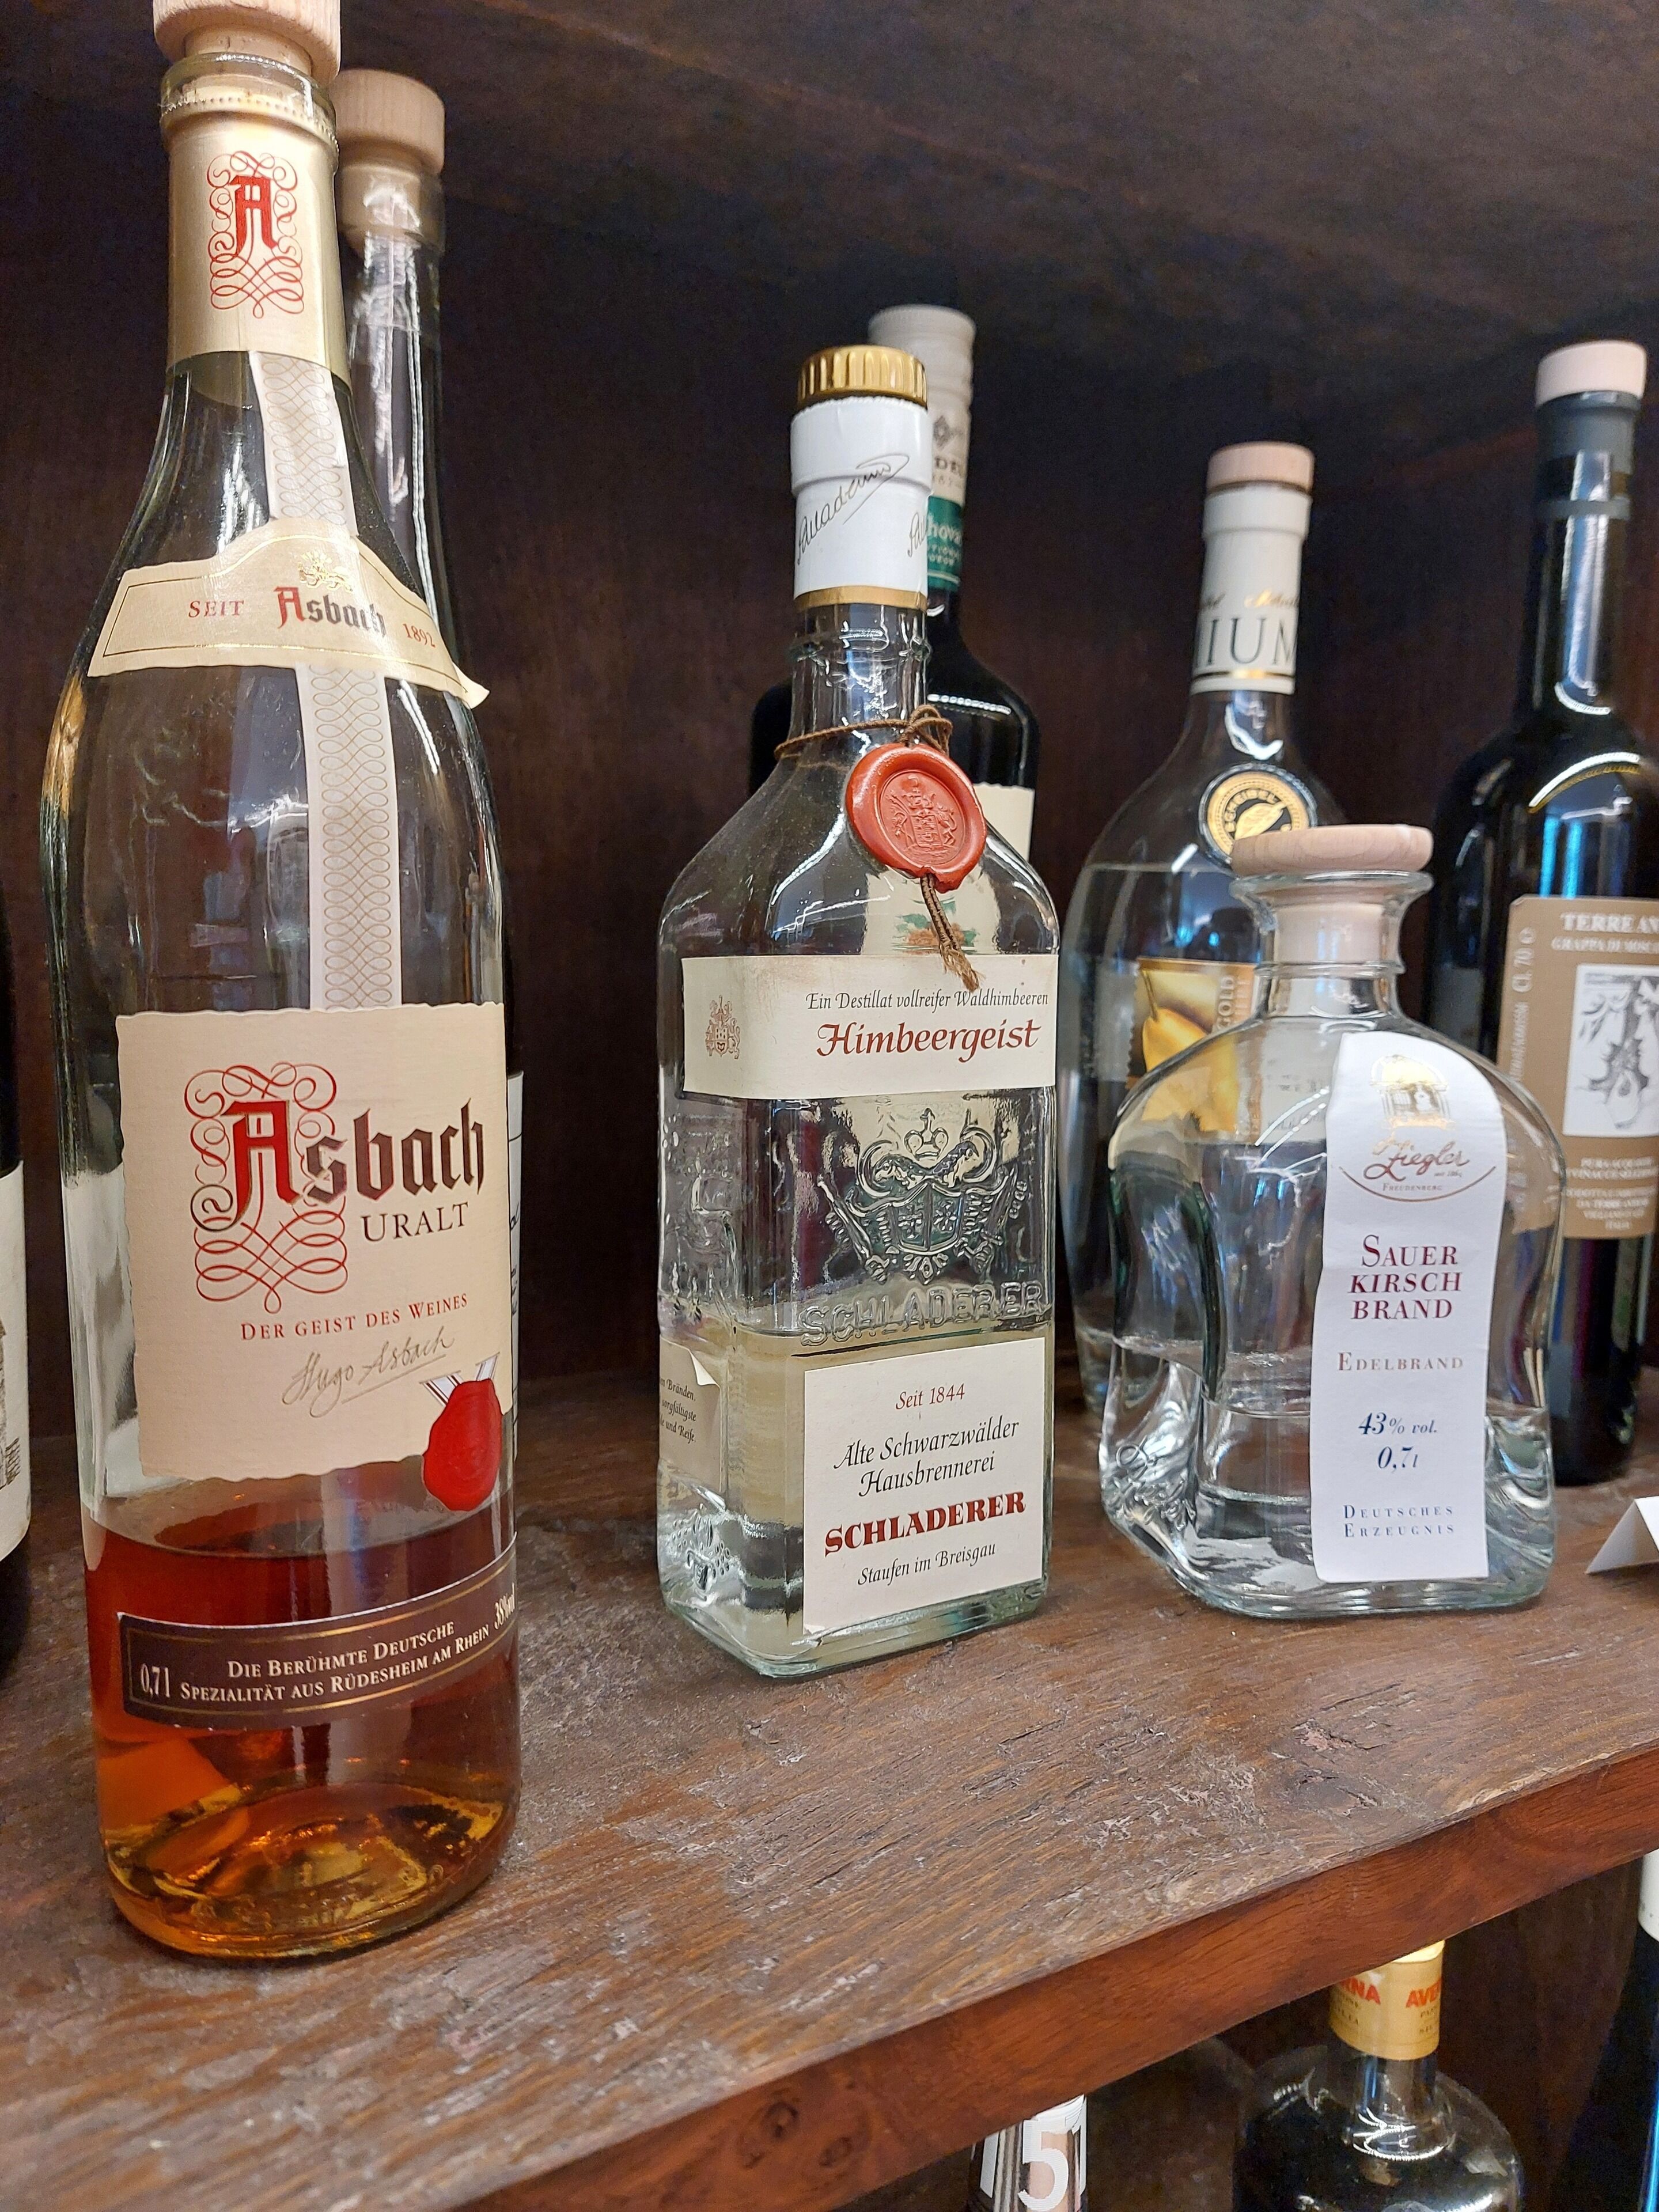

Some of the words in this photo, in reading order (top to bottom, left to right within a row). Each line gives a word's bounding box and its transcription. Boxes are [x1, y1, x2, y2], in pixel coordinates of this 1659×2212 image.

[187, 599, 245, 618] SEIT
[274, 586, 387, 638] Asbach
[403, 623, 436, 648] 1892
[806, 992, 831, 1009] Ein
[835, 989, 893, 1009] Destillat
[897, 988, 950, 1014] vollreifer
[954, 987, 1048, 1007] Waldhimbeeren
[816, 1018, 1042, 1063] Himbeergeist
[221, 1097, 485, 1221] Asbach
[361, 1202, 469, 1243] URALT
[1361, 1234, 1459, 1268] SAUER
[1347, 1271, 1463, 1294] KIRSCH
[241, 1323, 286, 1341] DER
[295, 1316, 356, 1337] GEIST
[366, 1308, 402, 1328] DES
[408, 1293, 468, 1320] WEINES
[798, 1280, 1045, 1347] SCHLADERER
[1350, 1298, 1453, 1320] BRAND
[282, 1351, 354, 1418] Hugo
[358, 1325, 456, 1386] Asbach
[1338, 1351, 1464, 1372] EDELBRAND
[895, 1389, 923, 1410] Seit
[929, 1382, 965, 1405] 1844
[666, 1421, 677, 1433] und
[833, 1439, 875, 1469] Alte
[880, 1414, 1020, 1461] Schwarzwälder
[1358, 1412, 1405, 1435] 43%
[858, 1450, 995, 1497] Hausbrennerei
[825, 1491, 1027, 1558] SCHLADERER
[1343, 1504, 1453, 1519] DEUTSCHES
[1344, 1522, 1454, 1538] ERZEUGNIS
[858, 1558, 910, 1586] Staufen
[915, 1557, 931, 1573] im
[935, 1543, 996, 1567] Breisgau
[180, 1681, 286, 1702] SPEZIALITÄT
[290, 1681, 324, 1699] AUS
[330, 1655, 429, 1694] RÜDESHEIM
[432, 1645, 452, 1665] AM
[454, 1624, 490, 1655] RHEIN
[228, 1660, 262, 1678] DIE
[267, 1649, 368, 1677] BERÜHMTE
[373, 1622, 454, 1661] DEUTSCHE
